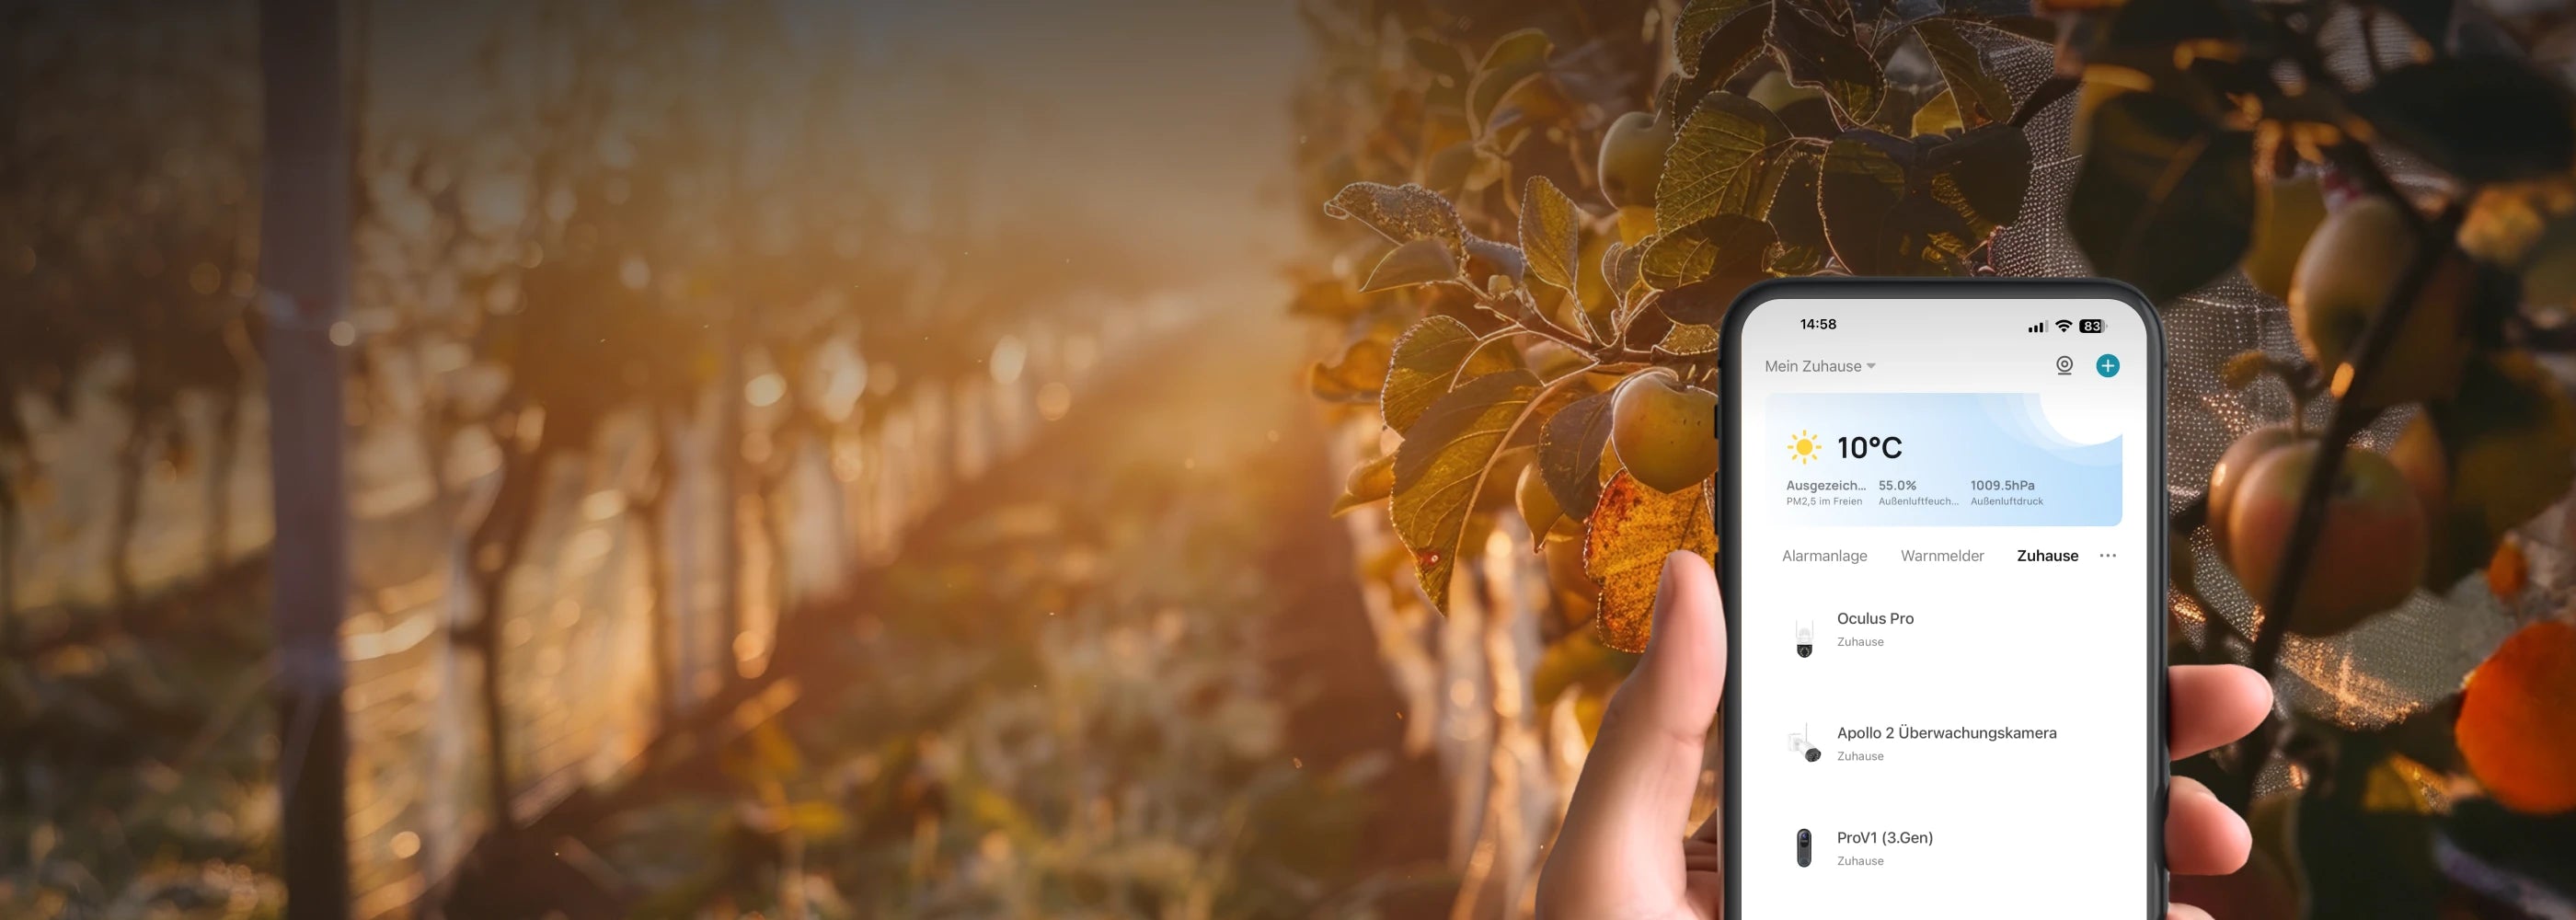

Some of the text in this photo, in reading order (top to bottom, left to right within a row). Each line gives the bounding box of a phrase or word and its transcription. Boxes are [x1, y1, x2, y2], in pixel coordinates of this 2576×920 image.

[1800, 318, 1837, 330] 14:58
[2084, 321, 2100, 331] 83
[1765, 359, 1862, 373] Mein Zuhause
[1838, 436, 1903, 459] 10°C
[1879, 479, 1917, 491] 55.0%
[1971, 479, 2035, 491] 1009.5hPa
[1787, 496, 1863, 508] PM2,5 im Freien
[1971, 496, 2044, 506] Außenluftdruck
[1782, 548, 1868, 565] Alarmanlage
[1901, 548, 1985, 562] Warnmelder
[2017, 548, 2079, 562] Zuhause
[1837, 612, 1915, 625] Oculus Pro
[1837, 637, 1885, 647] Zuhause
[1837, 723, 2057, 742] Apollo 2 Überwachungskamera
[1837, 751, 1885, 762] Zuhause
[1837, 831, 1934, 846] ProV1 (3.Gen)
[1837, 856, 1885, 866] Zuhause
